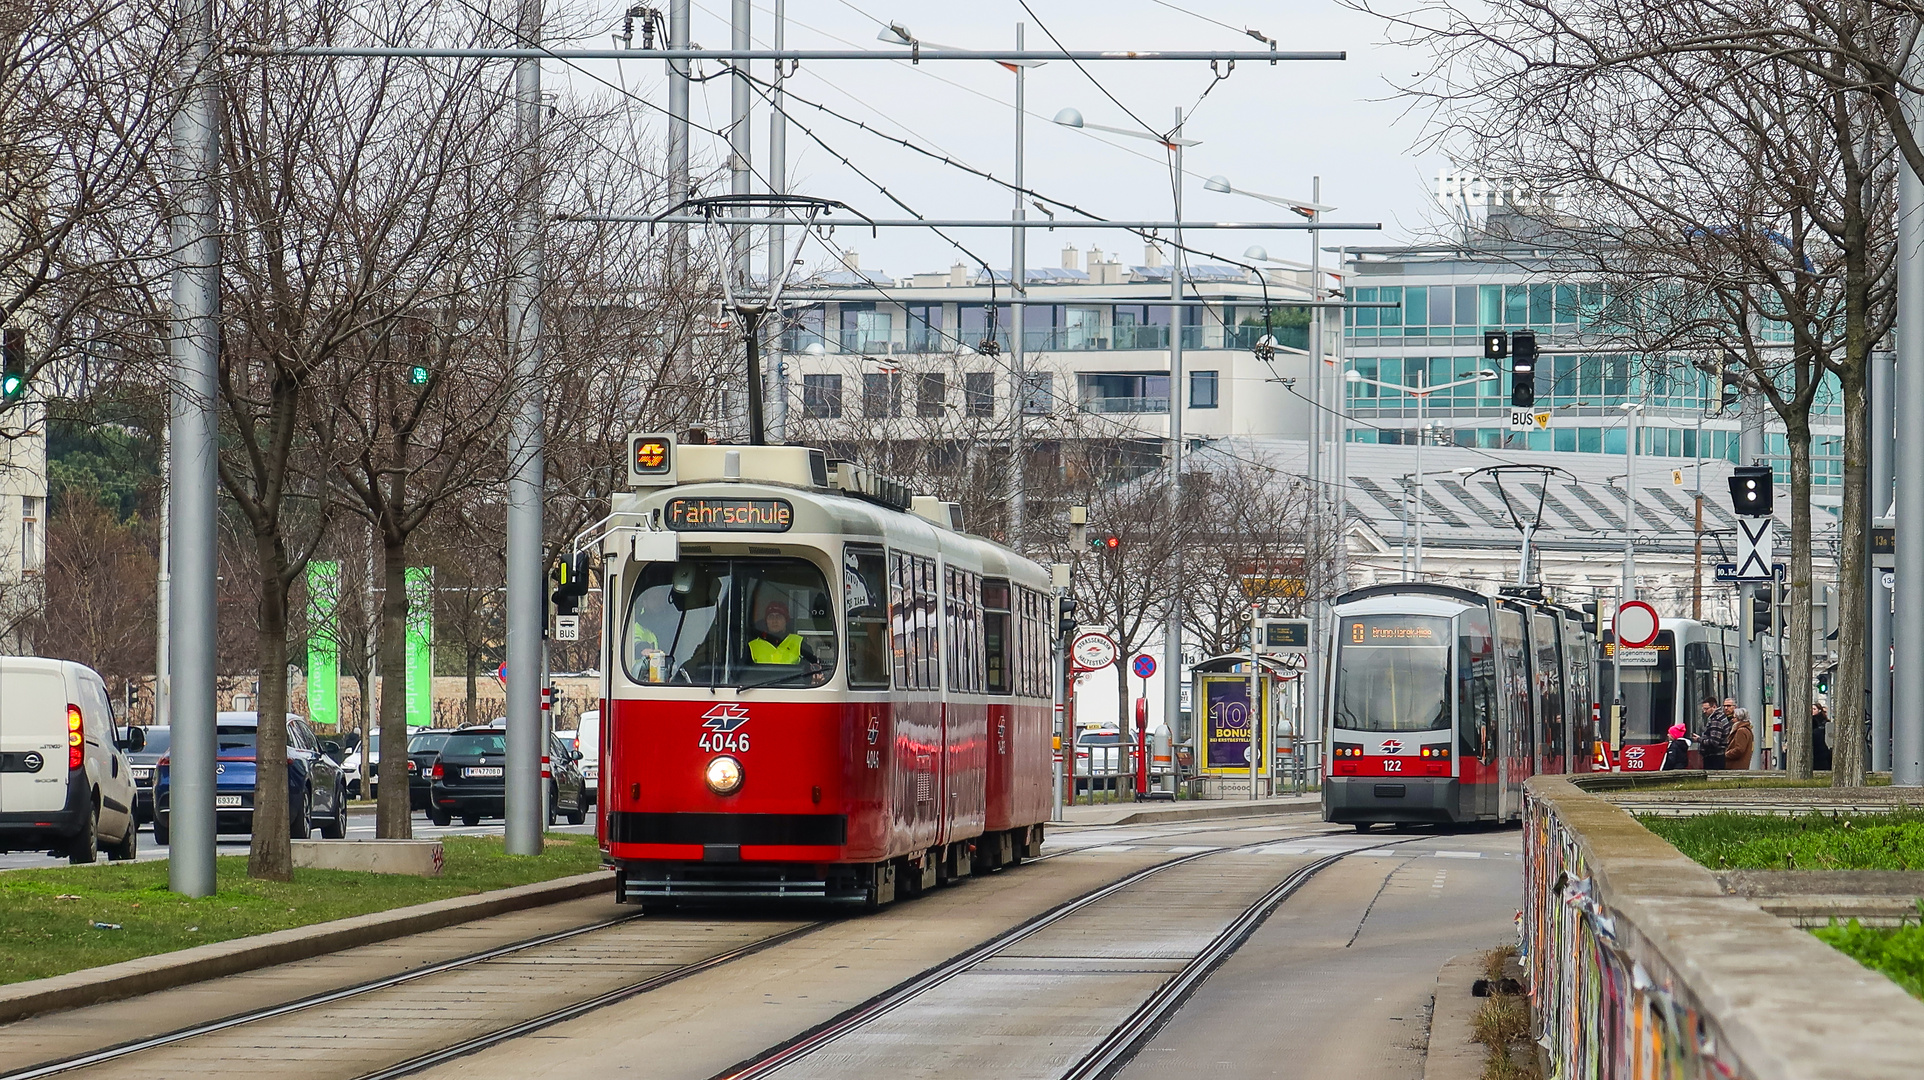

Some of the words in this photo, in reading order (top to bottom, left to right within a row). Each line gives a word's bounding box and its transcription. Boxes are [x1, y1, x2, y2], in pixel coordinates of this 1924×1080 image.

[1512, 412, 1533, 425] BUS
[1674, 472, 1681, 481] A
[673, 500, 790, 524] Fahrschule
[559, 629, 575, 638] BUS
[1077, 637, 1113, 650] STRASSENBAHN
[1078, 654, 1110, 666] HALTESTELLE
[698, 732, 750, 752] 4046
[1383, 759, 1402, 772] 122
[1627, 760, 1644, 769] 320
